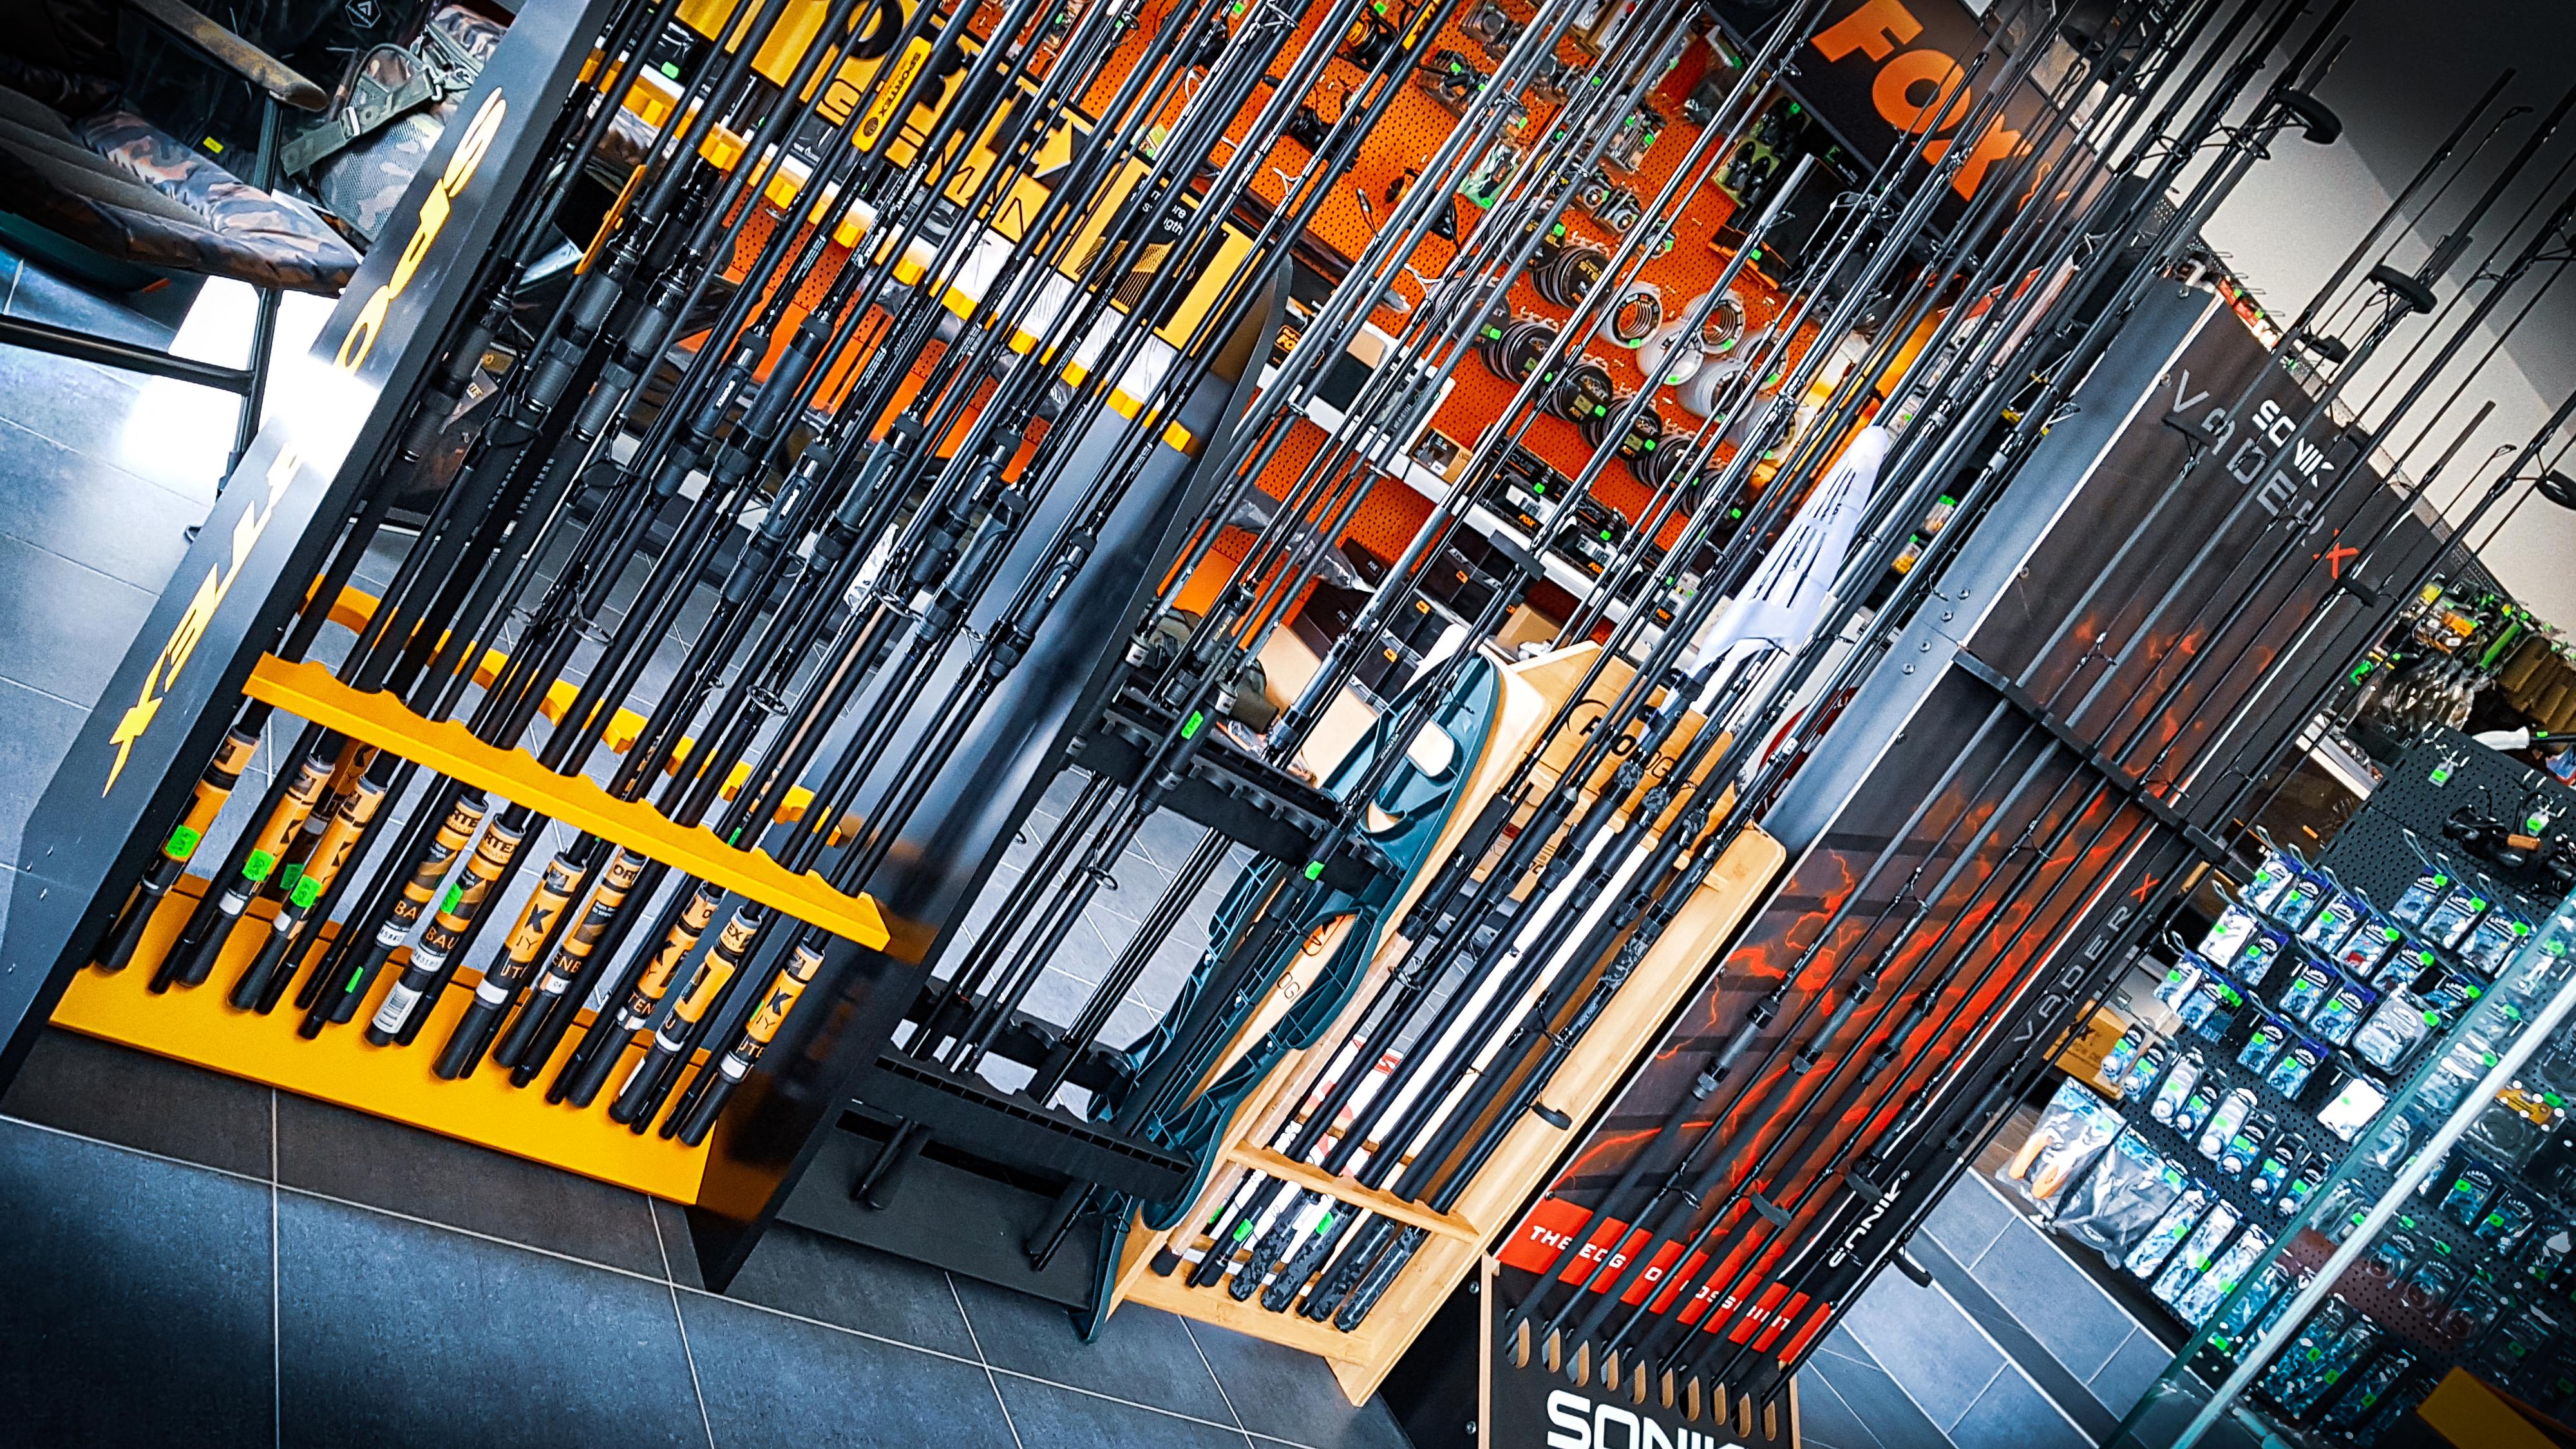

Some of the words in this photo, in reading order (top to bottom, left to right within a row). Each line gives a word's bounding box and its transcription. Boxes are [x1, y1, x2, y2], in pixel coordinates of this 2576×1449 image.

[876, 51, 923, 117] SPORTEX
[1810, 0, 2033, 202] FOX
[862, 225, 888, 259] SPORTEX
[1276, 334, 1296, 350] FO
[2252, 399, 2334, 488] SONIK
[2313, 528, 2359, 579] X
[2014, 905, 2133, 1042] VADER
[2130, 873, 2159, 902] X
[1530, 1226, 1573, 1251] THE
[1547, 1389, 1748, 1449] SON
